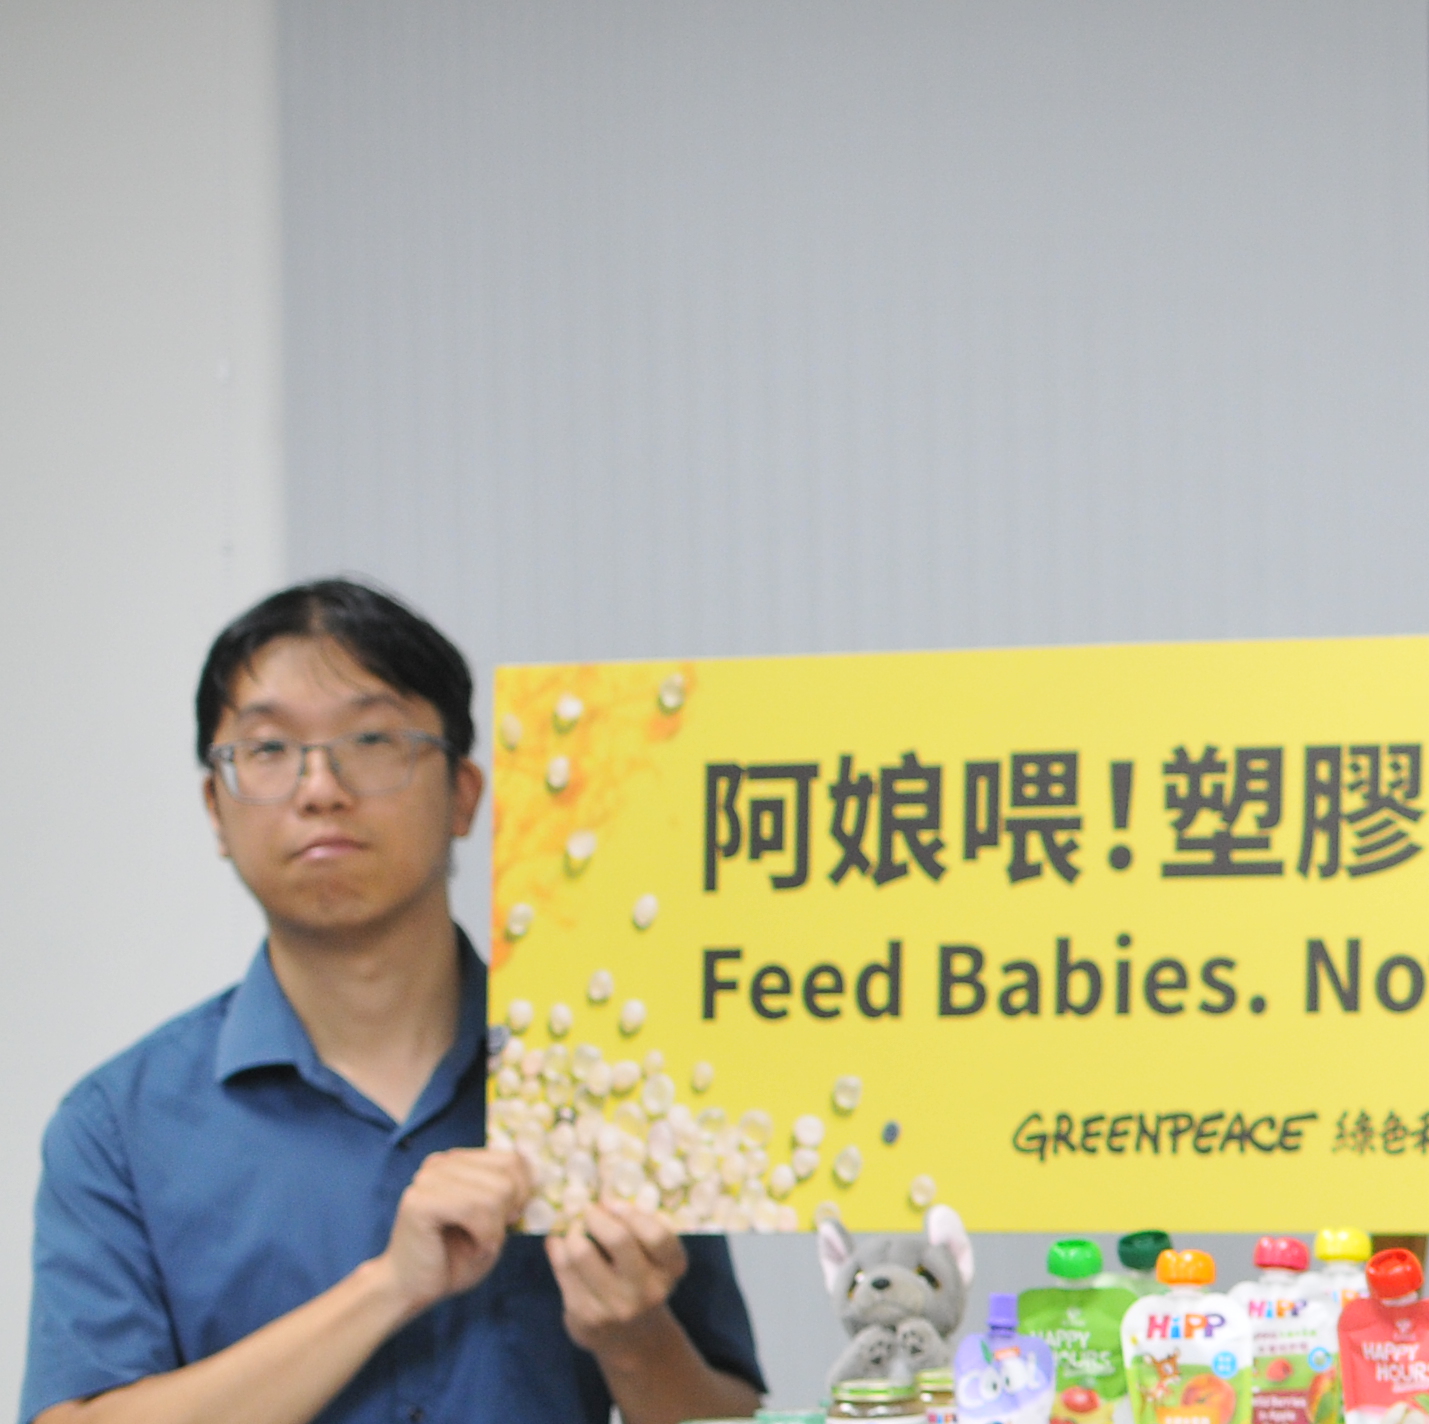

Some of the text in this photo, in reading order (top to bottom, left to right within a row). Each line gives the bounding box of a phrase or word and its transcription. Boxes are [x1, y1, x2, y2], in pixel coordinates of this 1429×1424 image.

[702, 940, 902, 1020] Feed
[937, 934, 1266, 1017] Babies.
[1012, 1110, 1318, 1162] GREENPEACE
[1147, 1313, 1226, 1340] HiPP
[1362, 1340, 1420, 1361] HAPPY
